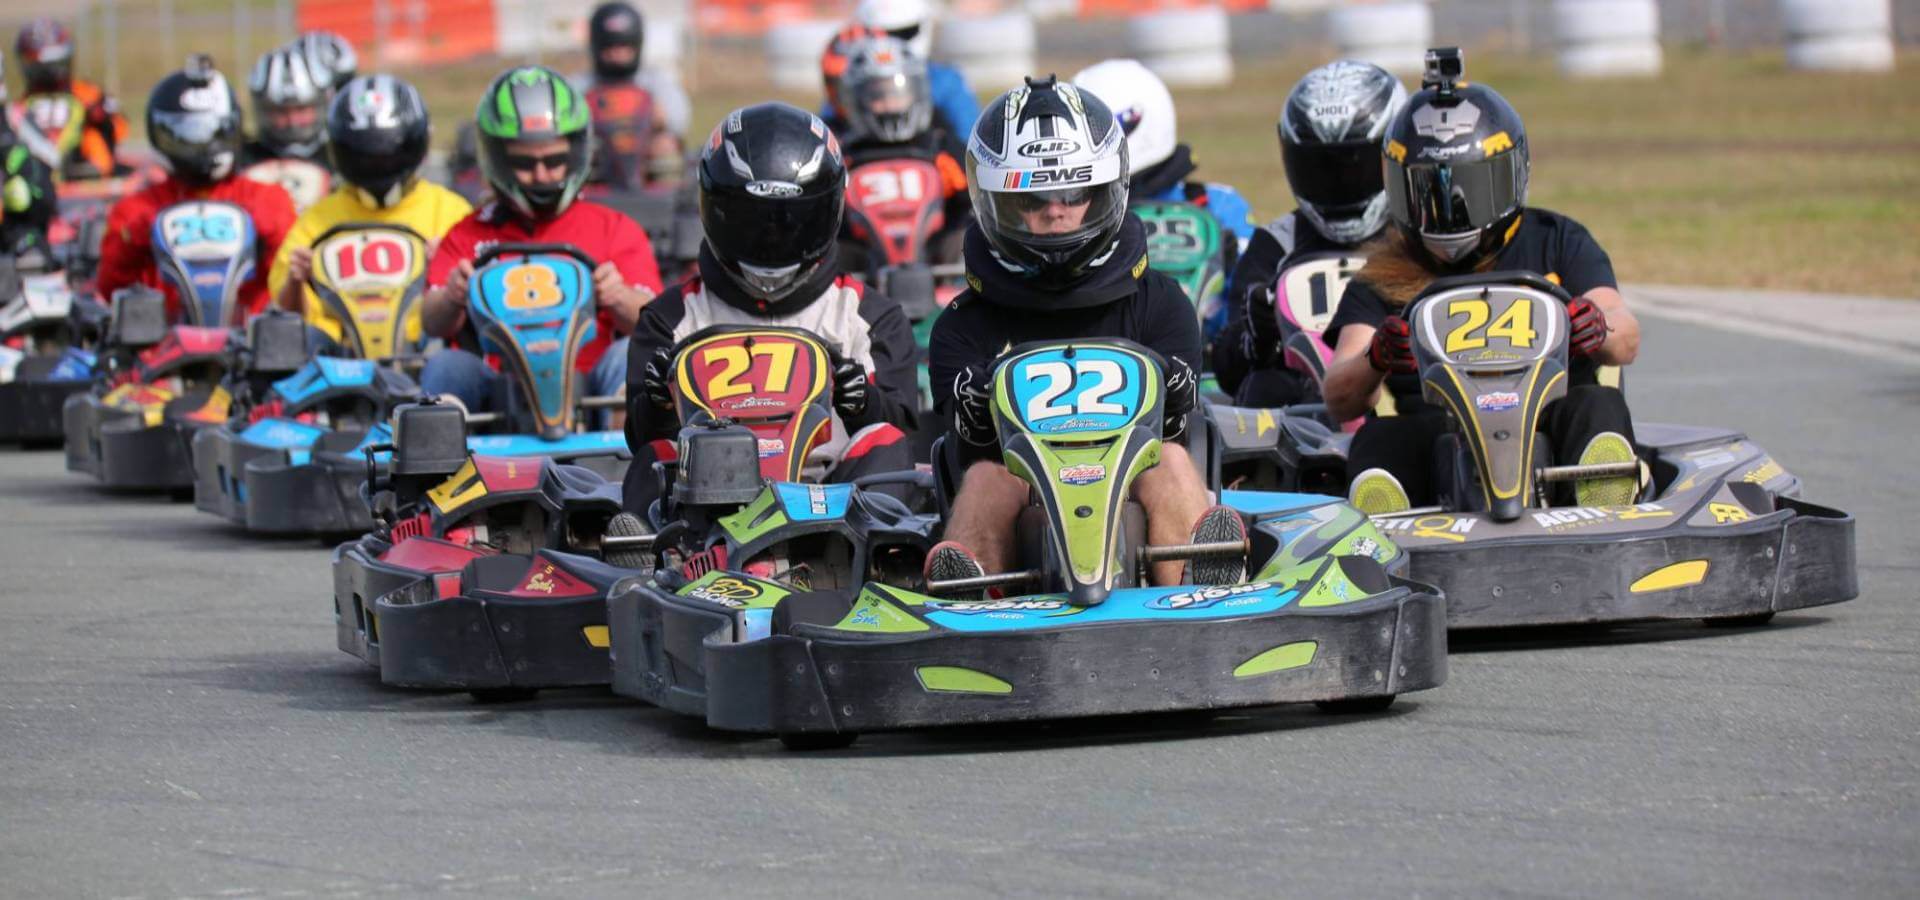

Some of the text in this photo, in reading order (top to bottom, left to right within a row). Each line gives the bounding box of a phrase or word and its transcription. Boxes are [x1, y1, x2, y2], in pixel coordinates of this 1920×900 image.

[1026, 142, 1072, 154] HJC
[861, 169, 922, 206] 31
[1030, 165, 1093, 185] SWS
[171, 214, 235, 247] 26
[338, 241, 405, 279] 10
[503, 264, 564, 309] 8
[1446, 298, 1538, 353] 24
[703, 343, 797, 401] 27
[1026, 360, 1127, 422] 22
